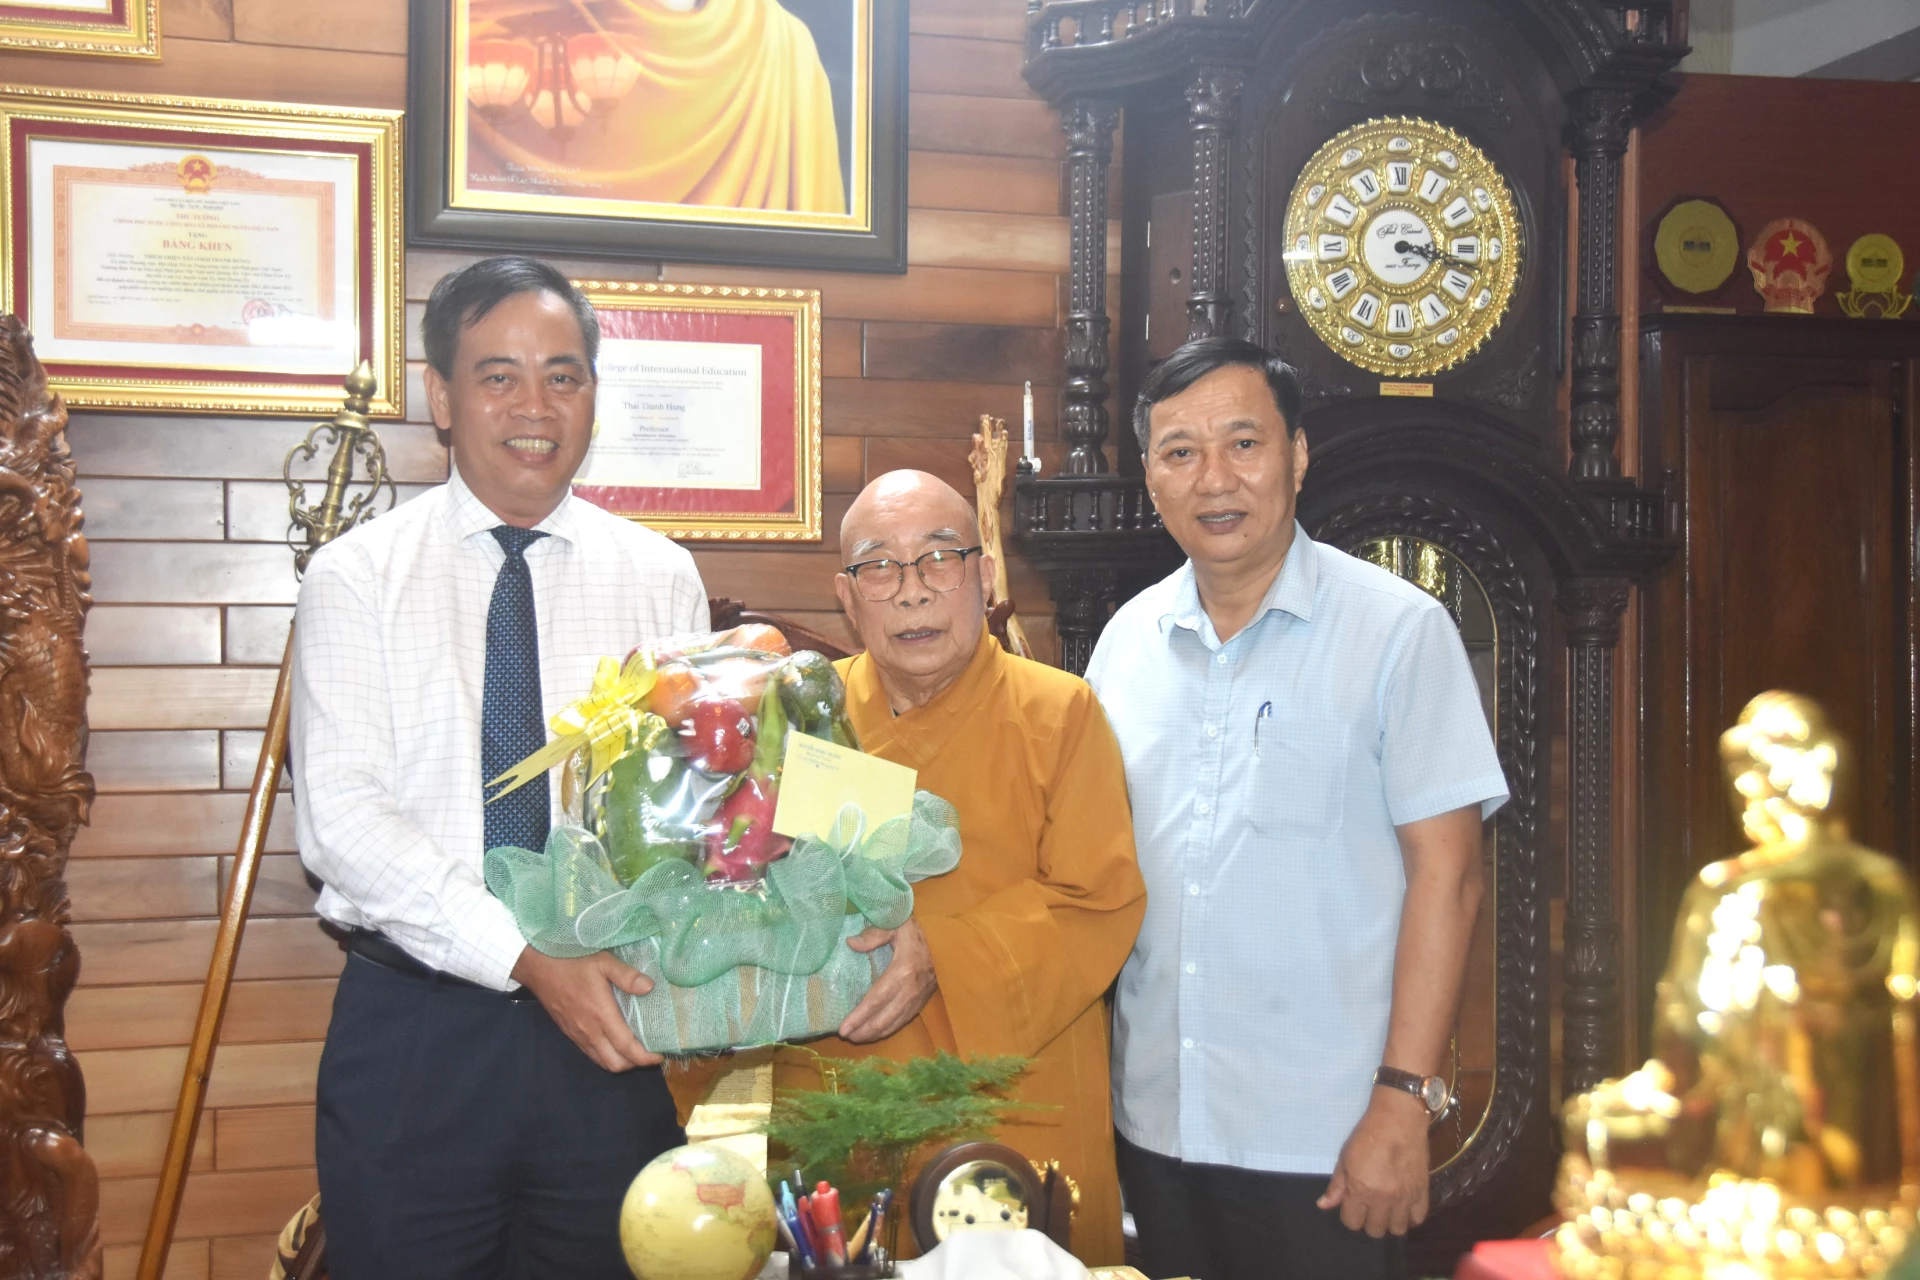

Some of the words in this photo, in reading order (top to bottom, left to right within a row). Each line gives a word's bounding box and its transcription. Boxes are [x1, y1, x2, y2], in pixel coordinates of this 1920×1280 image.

[1346, 150, 1357, 160] 55
[1394, 167, 1407, 185] XII
[1311, 187, 1321, 198] 50
[1334, 202, 1351, 219] X
[199, 241, 233, 252] KHEN
[601, 363, 628, 373] ollege
[630, 364, 639, 373] of
[641, 364, 700, 375] International
[702, 366, 747, 376] Education
[622, 401, 639, 410] Thai
[642, 402, 664, 411] Thanh
[666, 403, 686, 412] Hung
